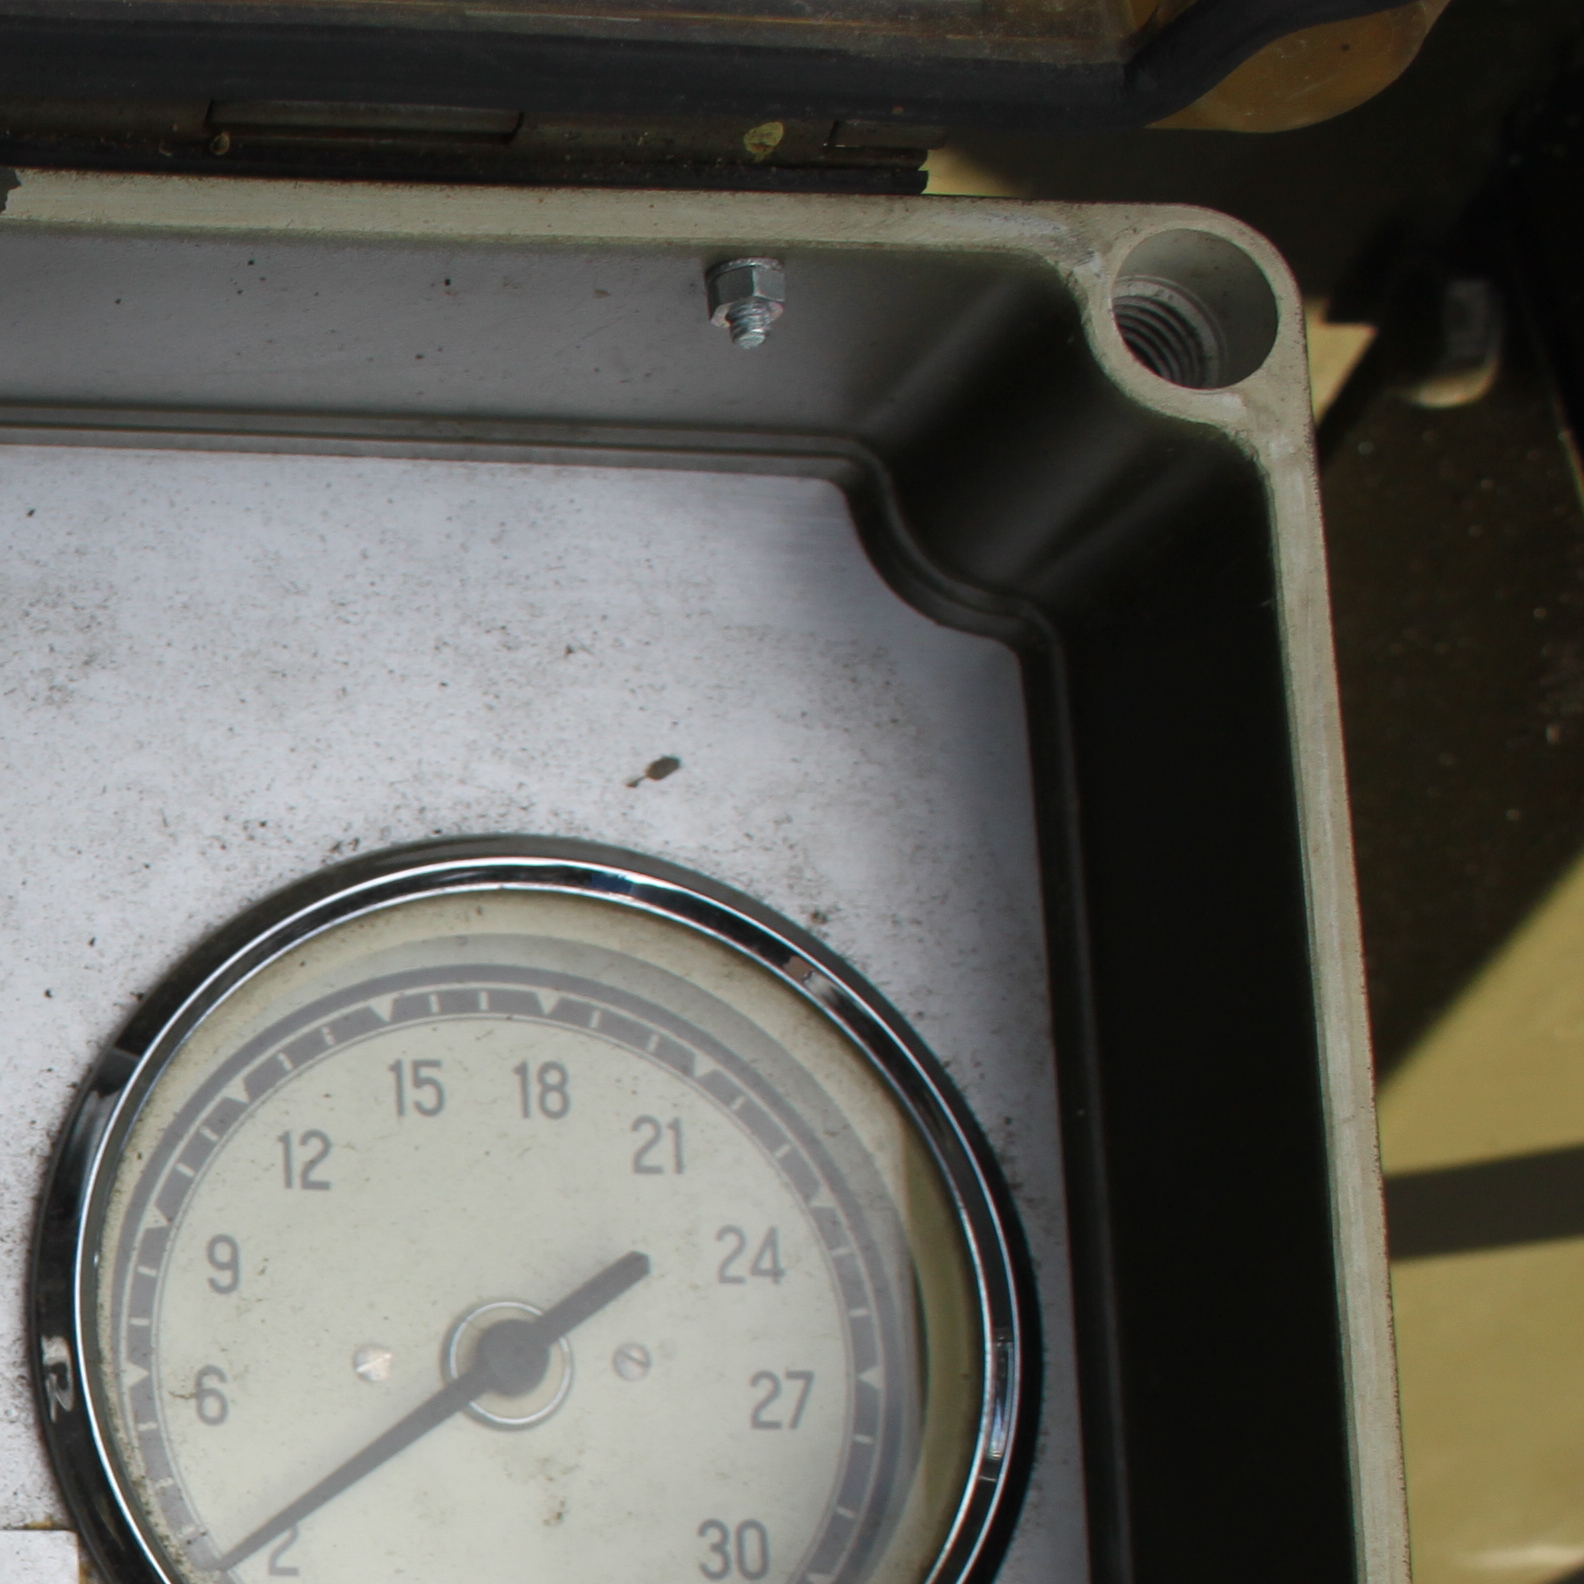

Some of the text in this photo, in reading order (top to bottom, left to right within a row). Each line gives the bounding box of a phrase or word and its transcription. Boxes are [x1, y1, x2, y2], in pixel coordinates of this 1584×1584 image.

[387, 1058, 446, 1118] 15
[512, 1060, 571, 1121] 18
[276, 1128, 334, 1192] 12
[630, 1114, 688, 1176] 21
[205, 1233, 242, 1296] 9
[715, 1224, 787, 1286] 24
[194, 1364, 230, 1426] 6
[750, 1369, 817, 1432] 27
[698, 1518, 770, 1584] 30
